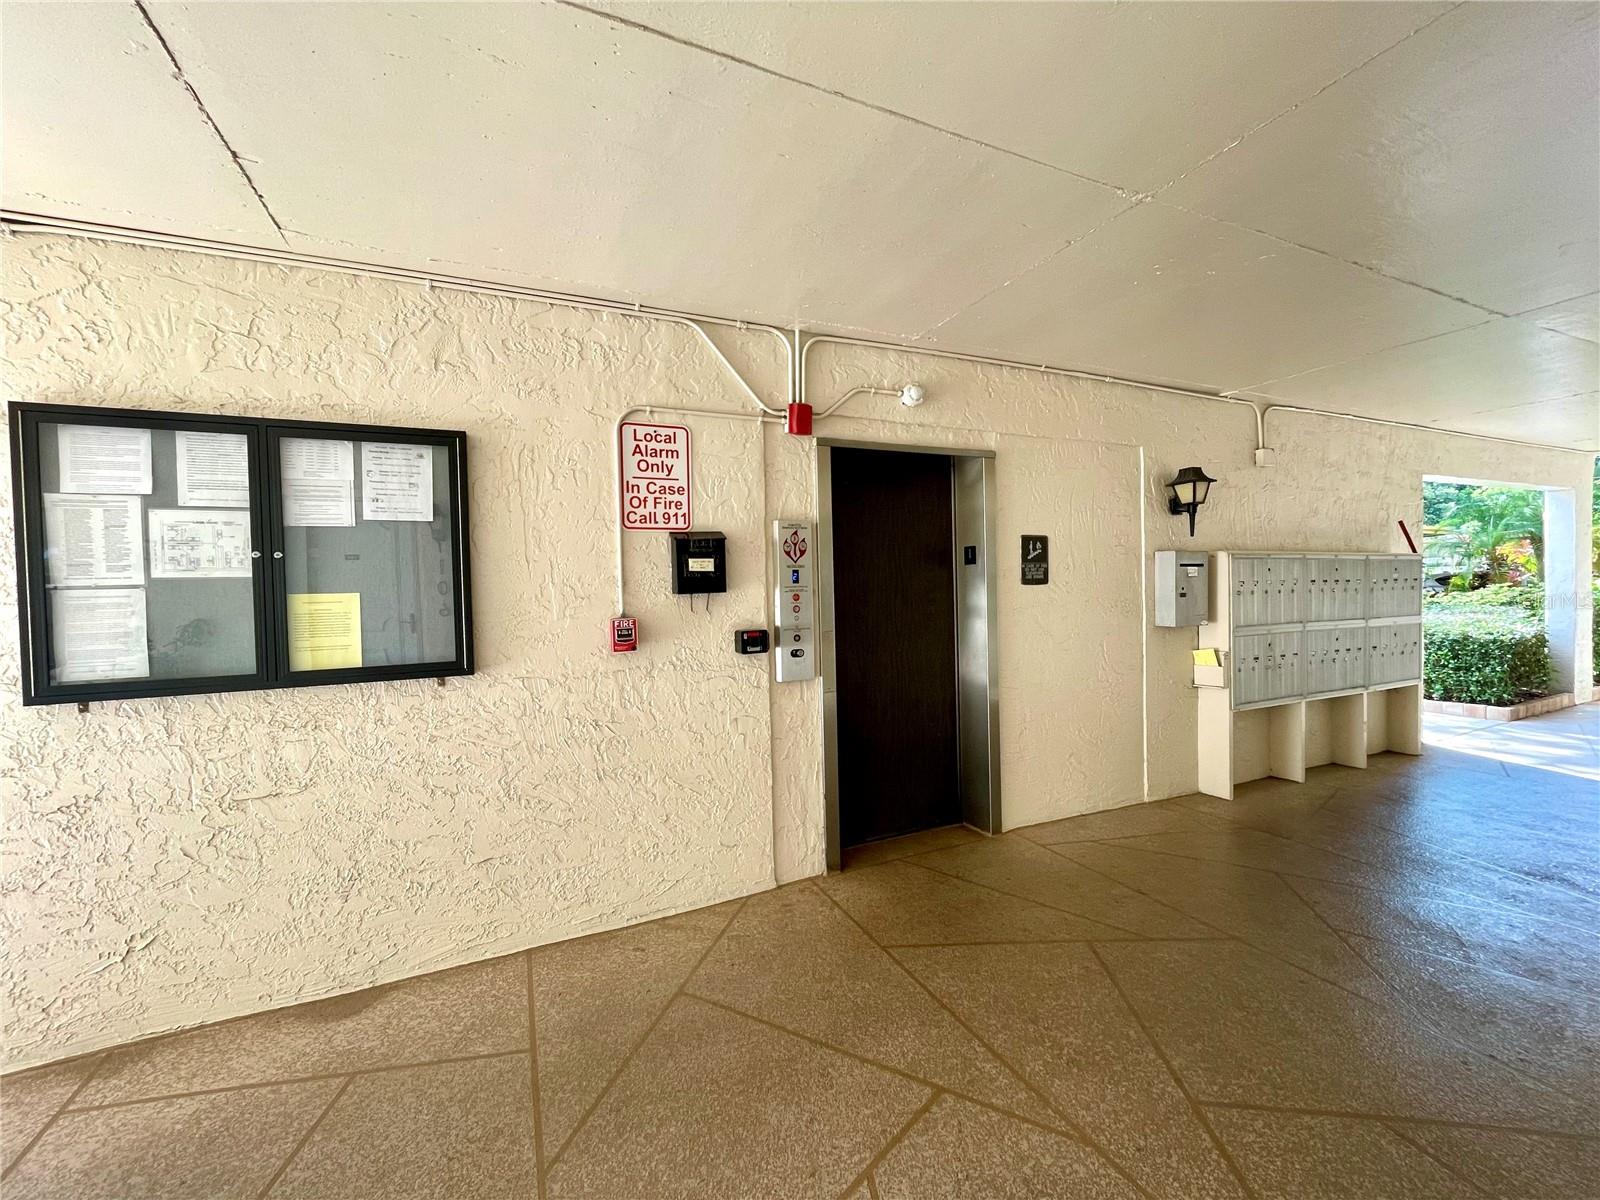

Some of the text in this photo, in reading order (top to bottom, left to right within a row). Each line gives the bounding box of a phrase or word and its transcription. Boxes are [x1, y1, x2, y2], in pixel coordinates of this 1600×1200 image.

[633, 428, 677, 444] Local
[632, 443, 680, 459] Alarm
[637, 459, 674, 477] Only
[626, 480, 686, 495] In Case
[629, 495, 683, 510] Of Fire
[626, 510, 687, 525] Call 911
[614, 619, 635, 628] FIRE
